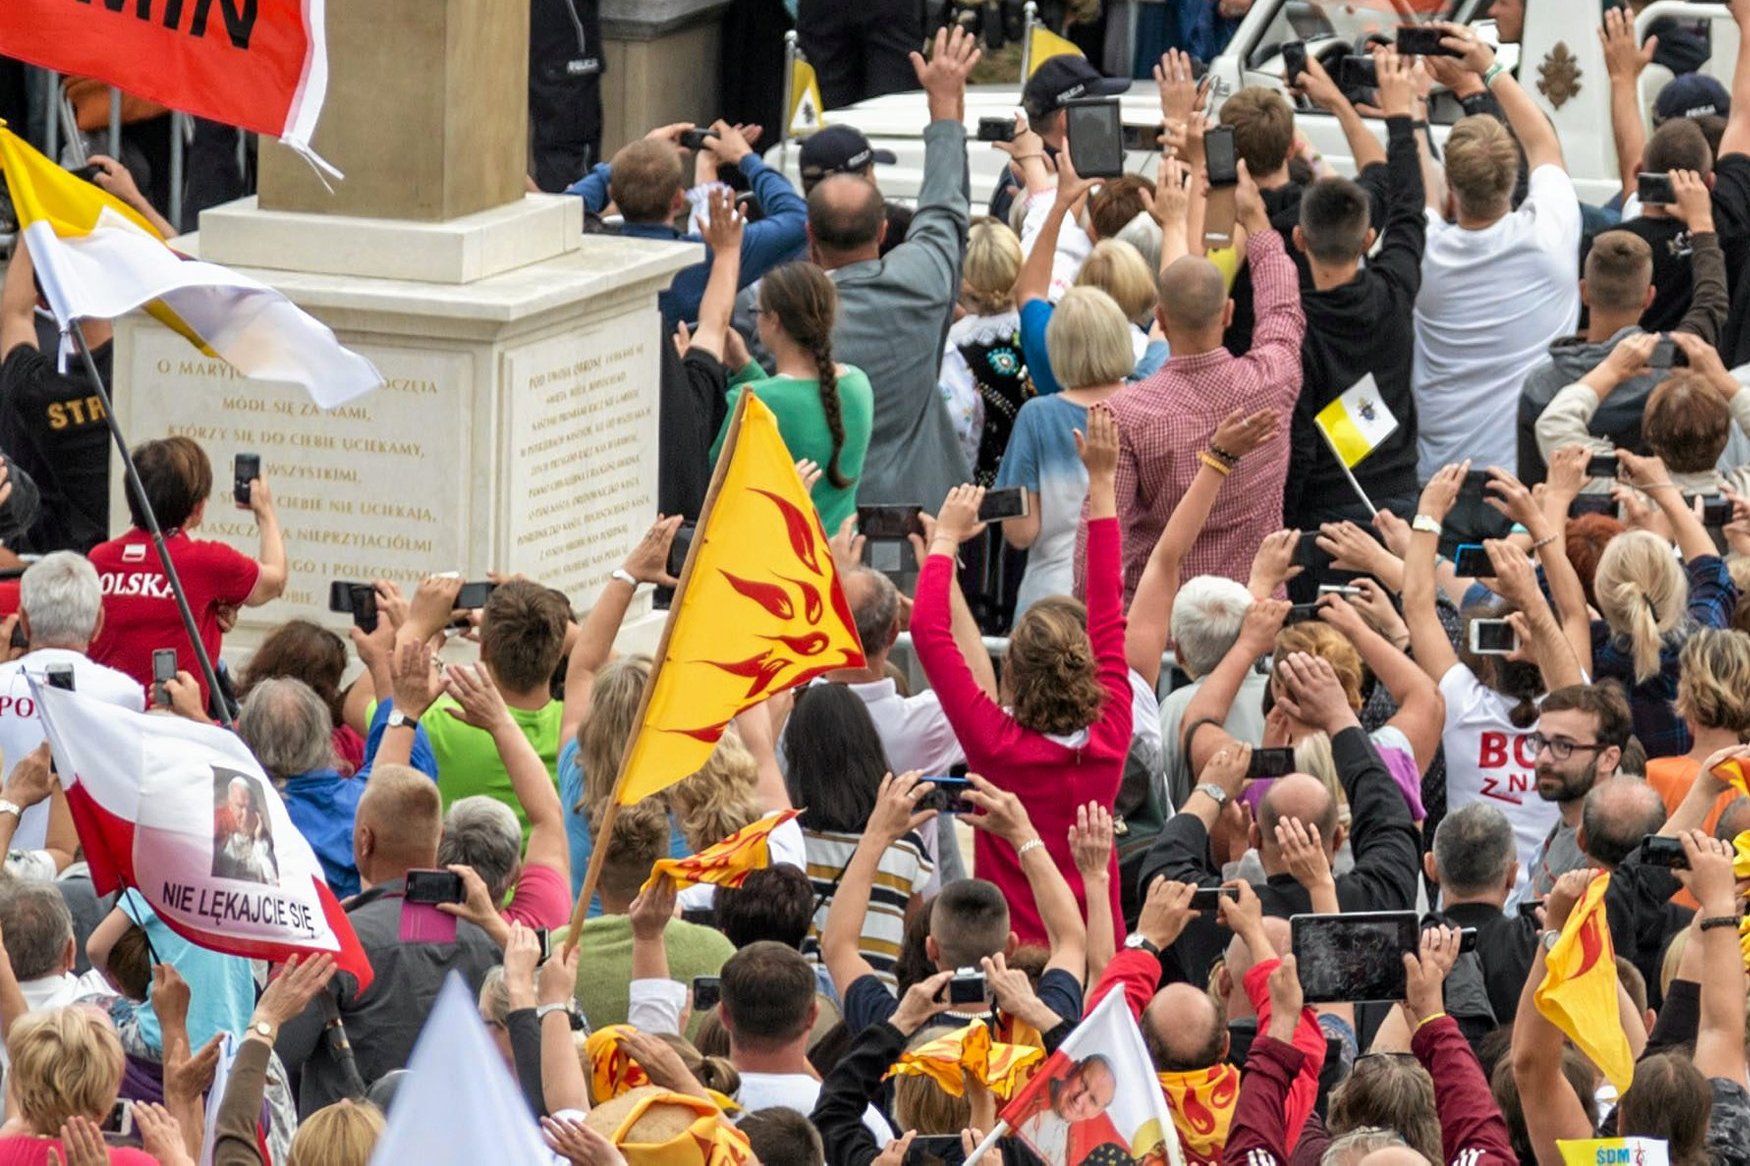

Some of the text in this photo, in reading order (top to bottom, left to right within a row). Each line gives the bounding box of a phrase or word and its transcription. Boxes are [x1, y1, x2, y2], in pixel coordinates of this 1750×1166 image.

[157, 359, 171, 374] O
[382, 376, 438, 394] OCZĘTA
[222, 395, 266, 411] MÓDL
[272, 401, 295, 417] SIĘ
[301, 403, 320, 416] ZA
[167, 423, 226, 440] KTÓRZY
[261, 432, 285, 445] DO
[290, 433, 336, 448] CIEBIE
[341, 437, 425, 459] UCIEKAMY,
[266, 463, 362, 484] WSZYSTKIMI,
[277, 494, 323, 512] CIEBIE
[329, 499, 354, 515] NIE
[359, 501, 437, 523] UCIEKAJĄ,
[99, 572, 178, 600] OLSKA
[163, 881, 315, 939] NIE LĘKAJCIE SIĘ
[1596, 1146, 1631, 1165] ŚDM
